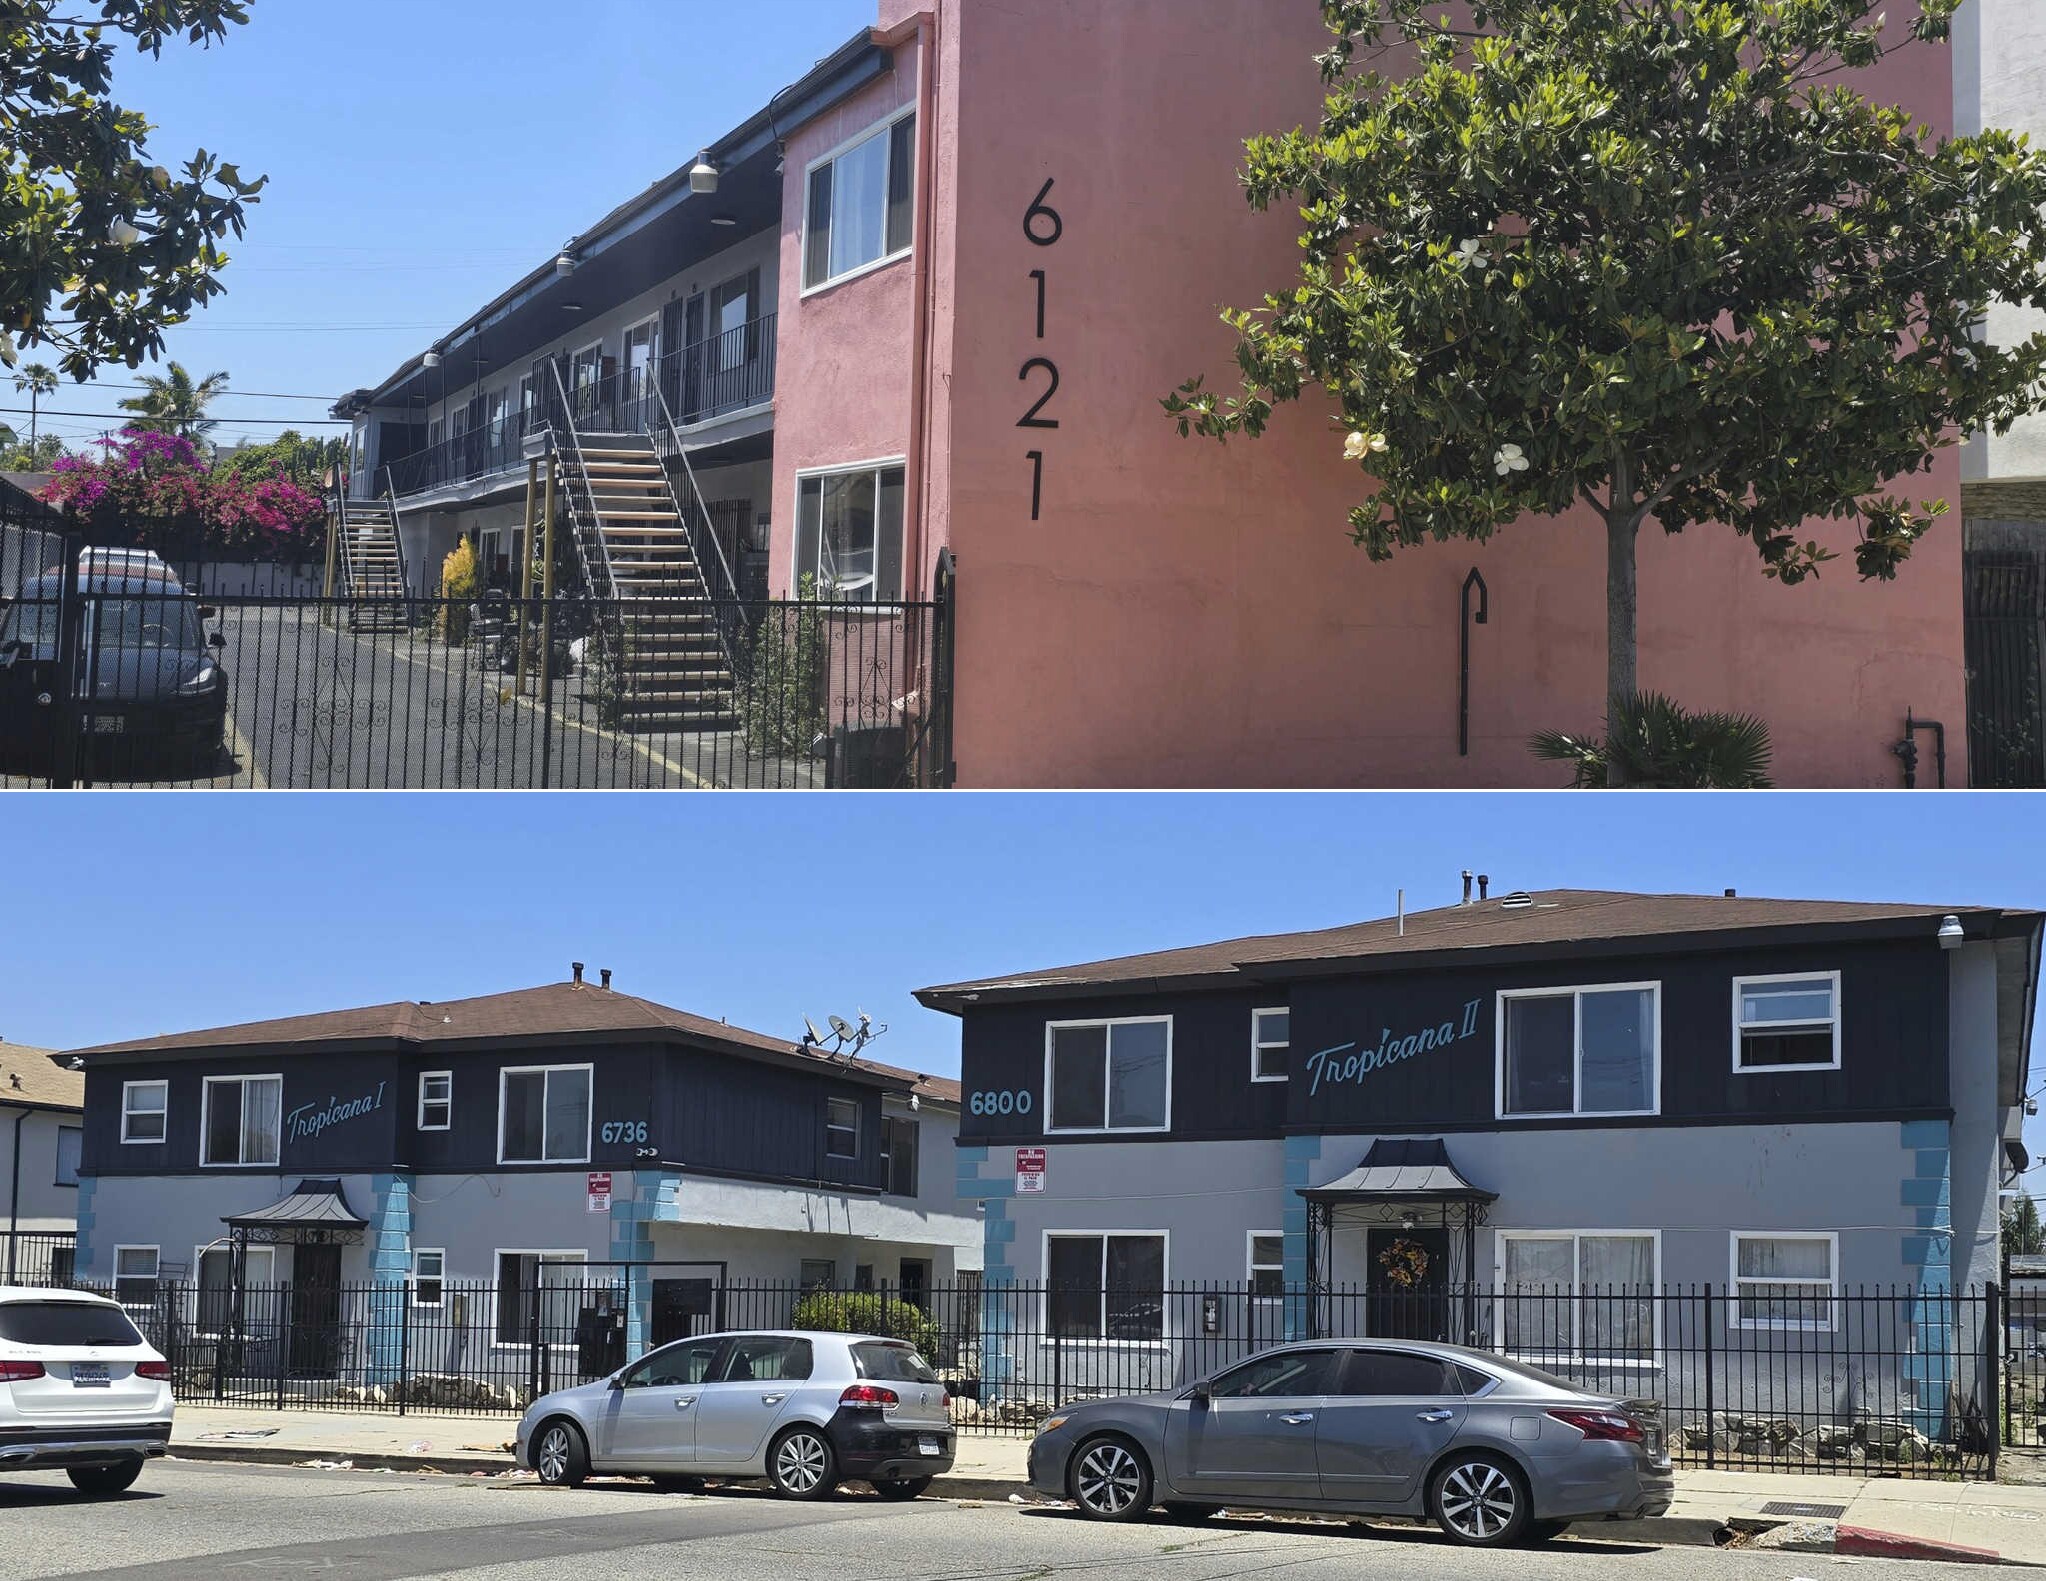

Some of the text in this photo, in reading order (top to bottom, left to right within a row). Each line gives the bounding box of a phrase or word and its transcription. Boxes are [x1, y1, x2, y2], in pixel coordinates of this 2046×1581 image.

[1015, 177, 1062, 521] 6121
[1306, 1022, 1455, 1096] Tropicana
[287, 1095, 373, 1145] Tropicana
[970, 1090, 1032, 1116] 6800
[601, 1121, 648, 1144] 6736
